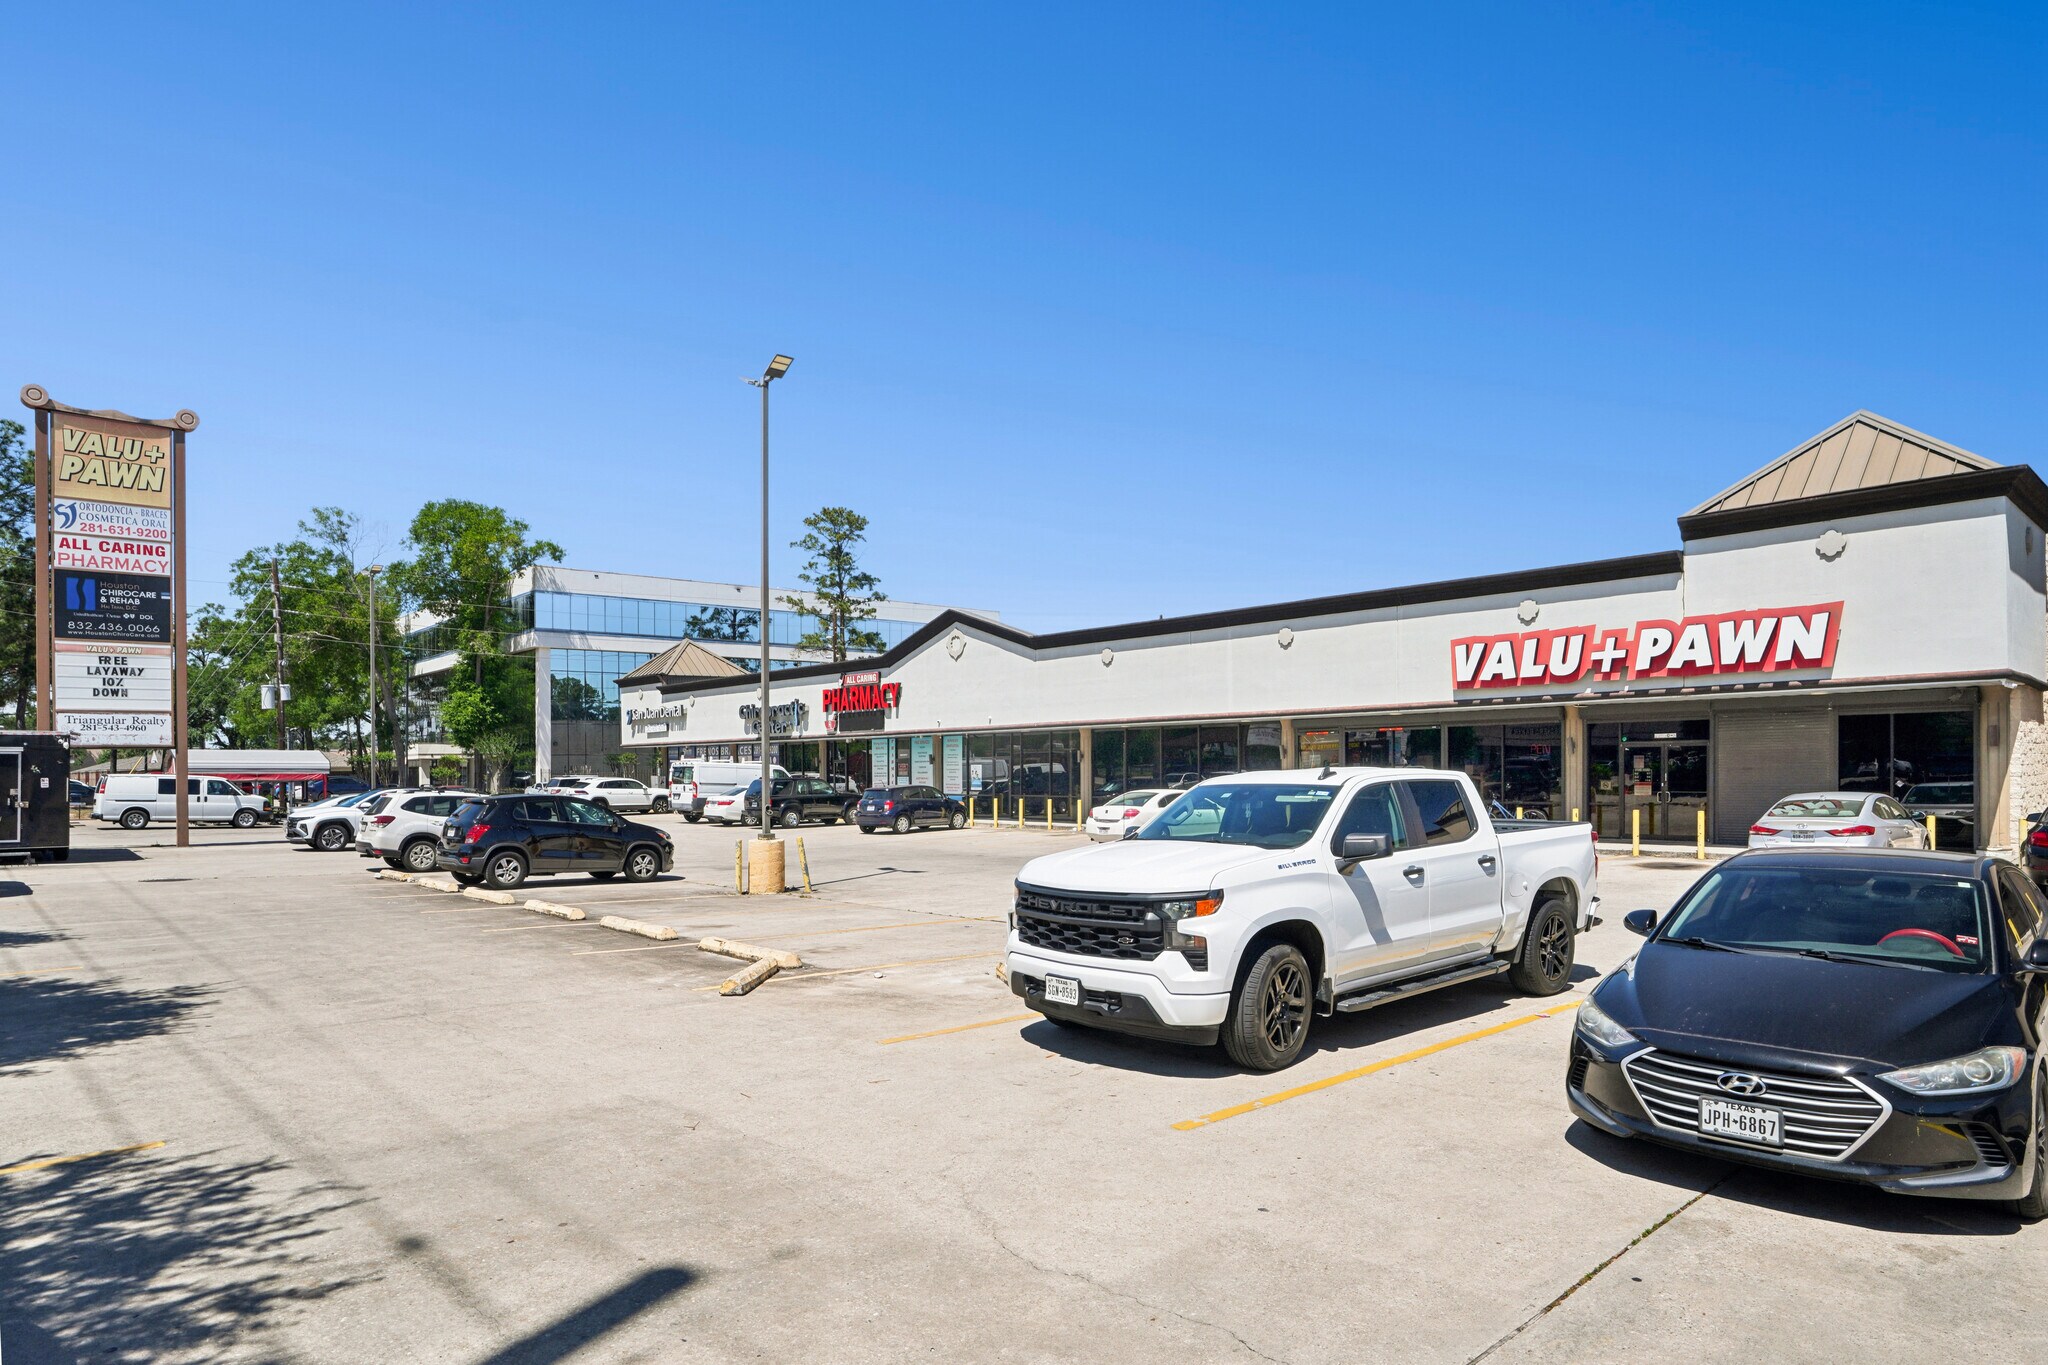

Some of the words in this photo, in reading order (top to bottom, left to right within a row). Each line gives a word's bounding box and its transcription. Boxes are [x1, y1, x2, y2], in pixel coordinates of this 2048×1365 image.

[59, 454, 166, 492] PAWN
[79, 502, 133, 516] ORTODONCIA
[141, 509, 168, 519] BRACES
[79, 512, 138, 526] COSMETICA
[142, 519, 167, 529] ORAL
[80, 522, 167, 540] 281-631-9200
[59, 537, 92, 551] ALL
[98, 541, 166, 557] CARING
[58, 552, 169, 573] PHARMACY
[100, 581, 140, 590] Houston
[100, 588, 157, 599] CHIROCARE
[110, 597, 140, 605] REHAB
[68, 621, 160, 633] 832.436.0066
[98, 656, 128, 665] FREE
[87, 666, 145, 676] LAYAWAY
[102, 677, 124, 687] 10%
[846, 675, 856, 684] ALL
[857, 673, 877, 683] CARING
[93, 688, 128, 697] DOWN
[822, 682, 902, 712] PHARMACY
[660, 705, 684, 717] Dental
[64, 715, 127, 726] Triangular
[132, 716, 167, 727] Realty
[80, 724, 147, 732] 281-543-4960
[1020, 894, 1146, 917] CHEVROLET
[1725, 1102, 1756, 1113] TEXAS
